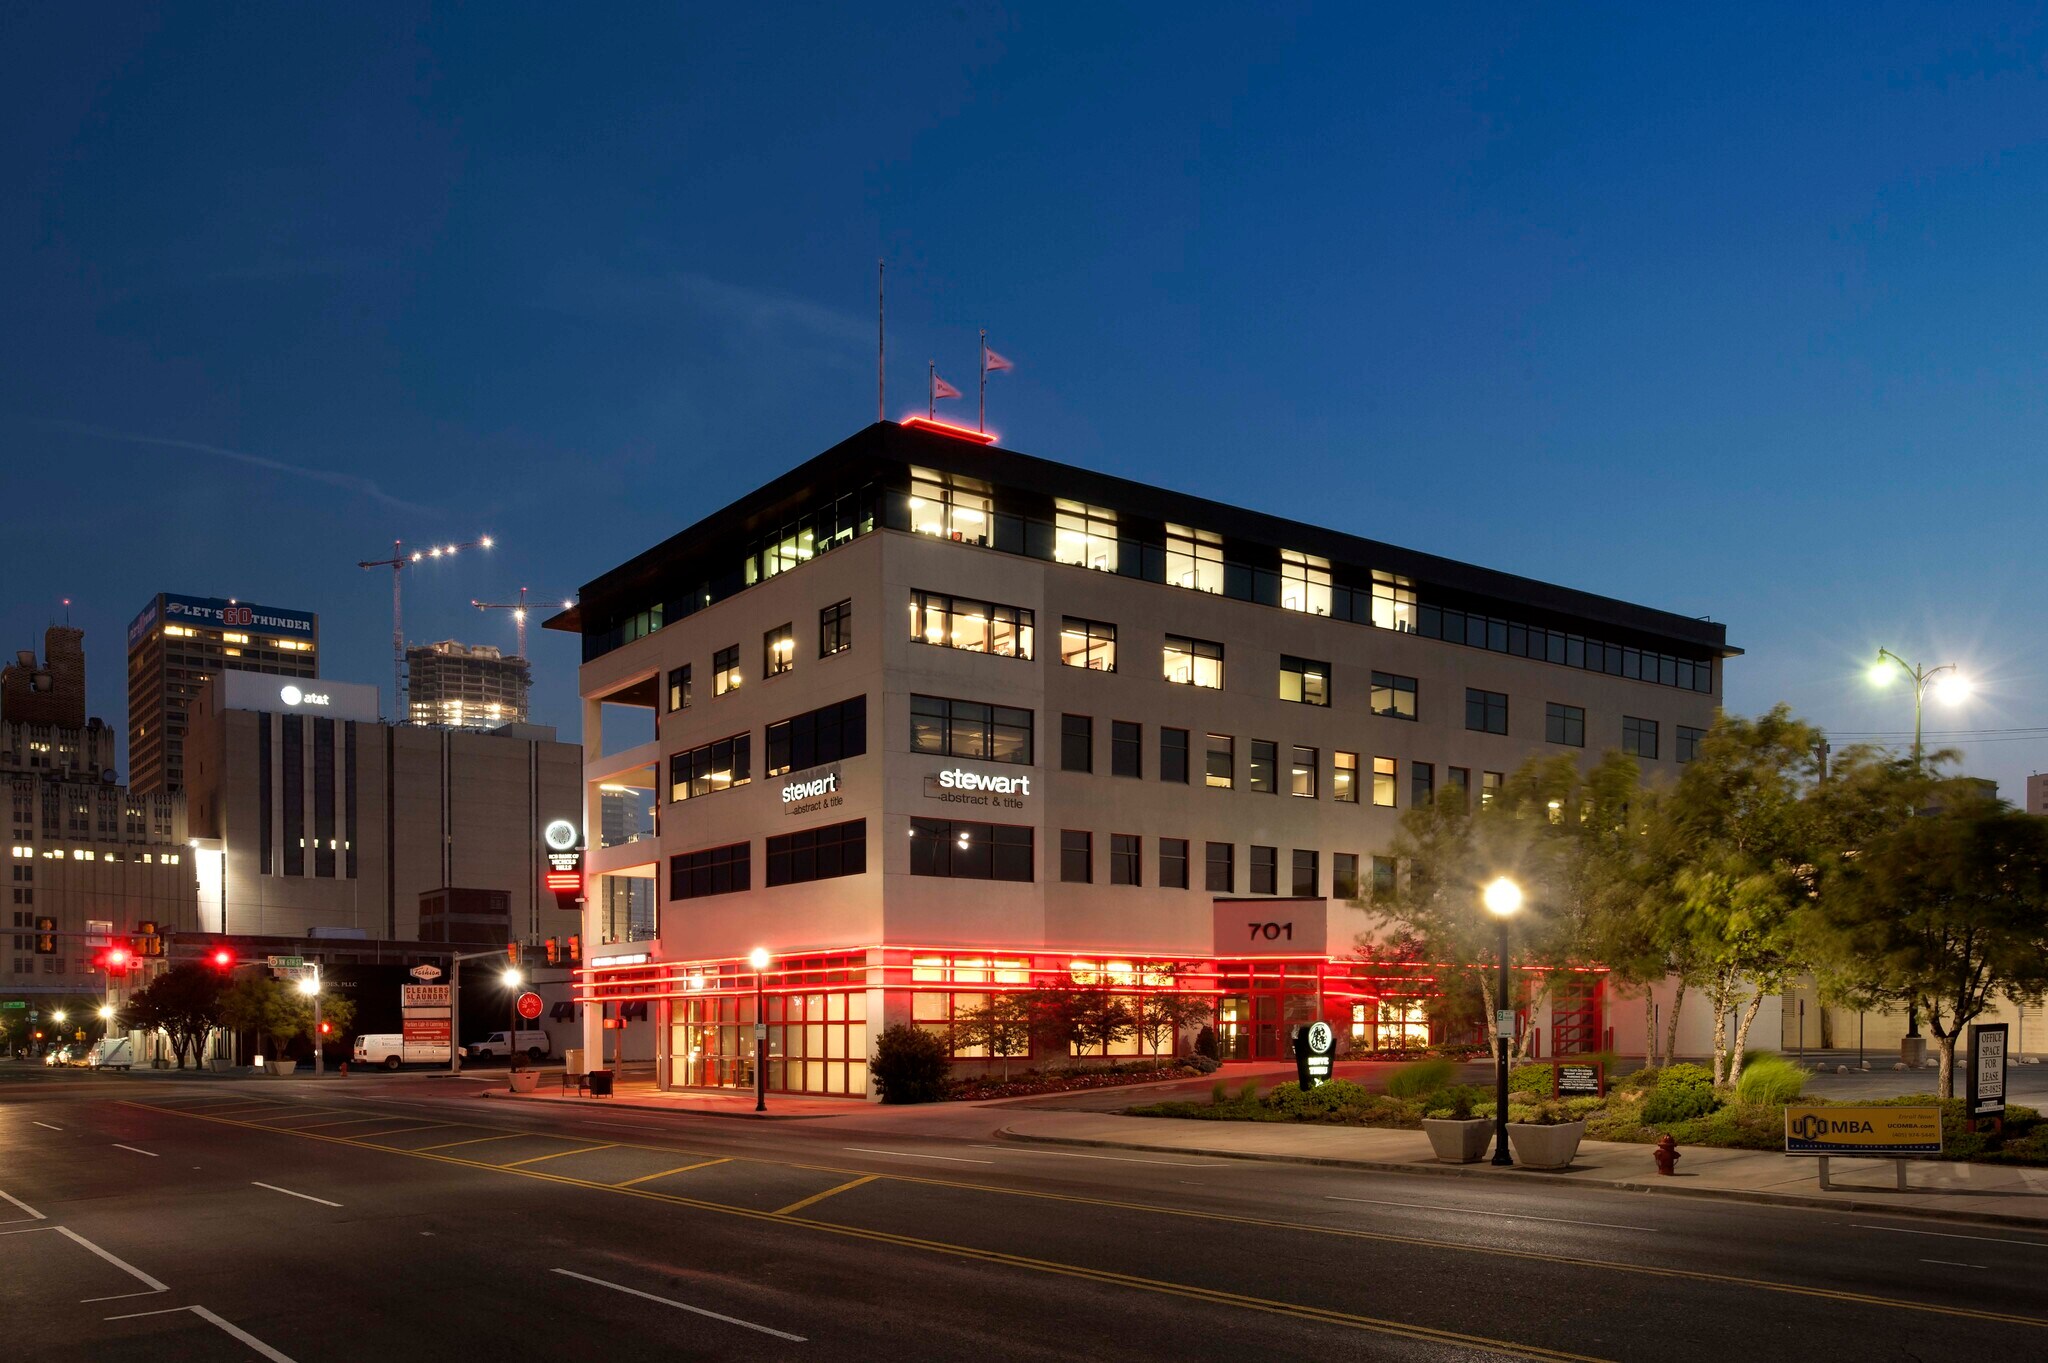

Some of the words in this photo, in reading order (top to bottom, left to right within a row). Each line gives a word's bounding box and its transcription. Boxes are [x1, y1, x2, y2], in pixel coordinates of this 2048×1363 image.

[183, 605, 224, 620] LET'S
[223, 607, 253, 626] GO
[252, 614, 311, 631] THUNDER
[782, 772, 836, 803] stewart
[939, 768, 1030, 796] stewart
[793, 800, 822, 816] abstract
[823, 798, 829, 809] &
[830, 796, 843, 807] title
[940, 792, 989, 806] abstract
[992, 796, 1001, 807] &
[1003, 797, 1024, 809] title
[1247, 922, 1293, 941] 701
[278, 958, 286, 966] NW
[414, 966, 440, 976] Fashion
[1981, 1032, 2002, 1043] OFFICE
[1982, 1046, 2000, 1056] SPACE
[1985, 1058, 1997, 1069] FOR
[1982, 1071, 1999, 1082] LEASE
[1979, 1084, 2001, 1095] 605-0825
[1793, 1113, 1828, 1141] UCO
[1831, 1121, 1874, 1134] MBA
